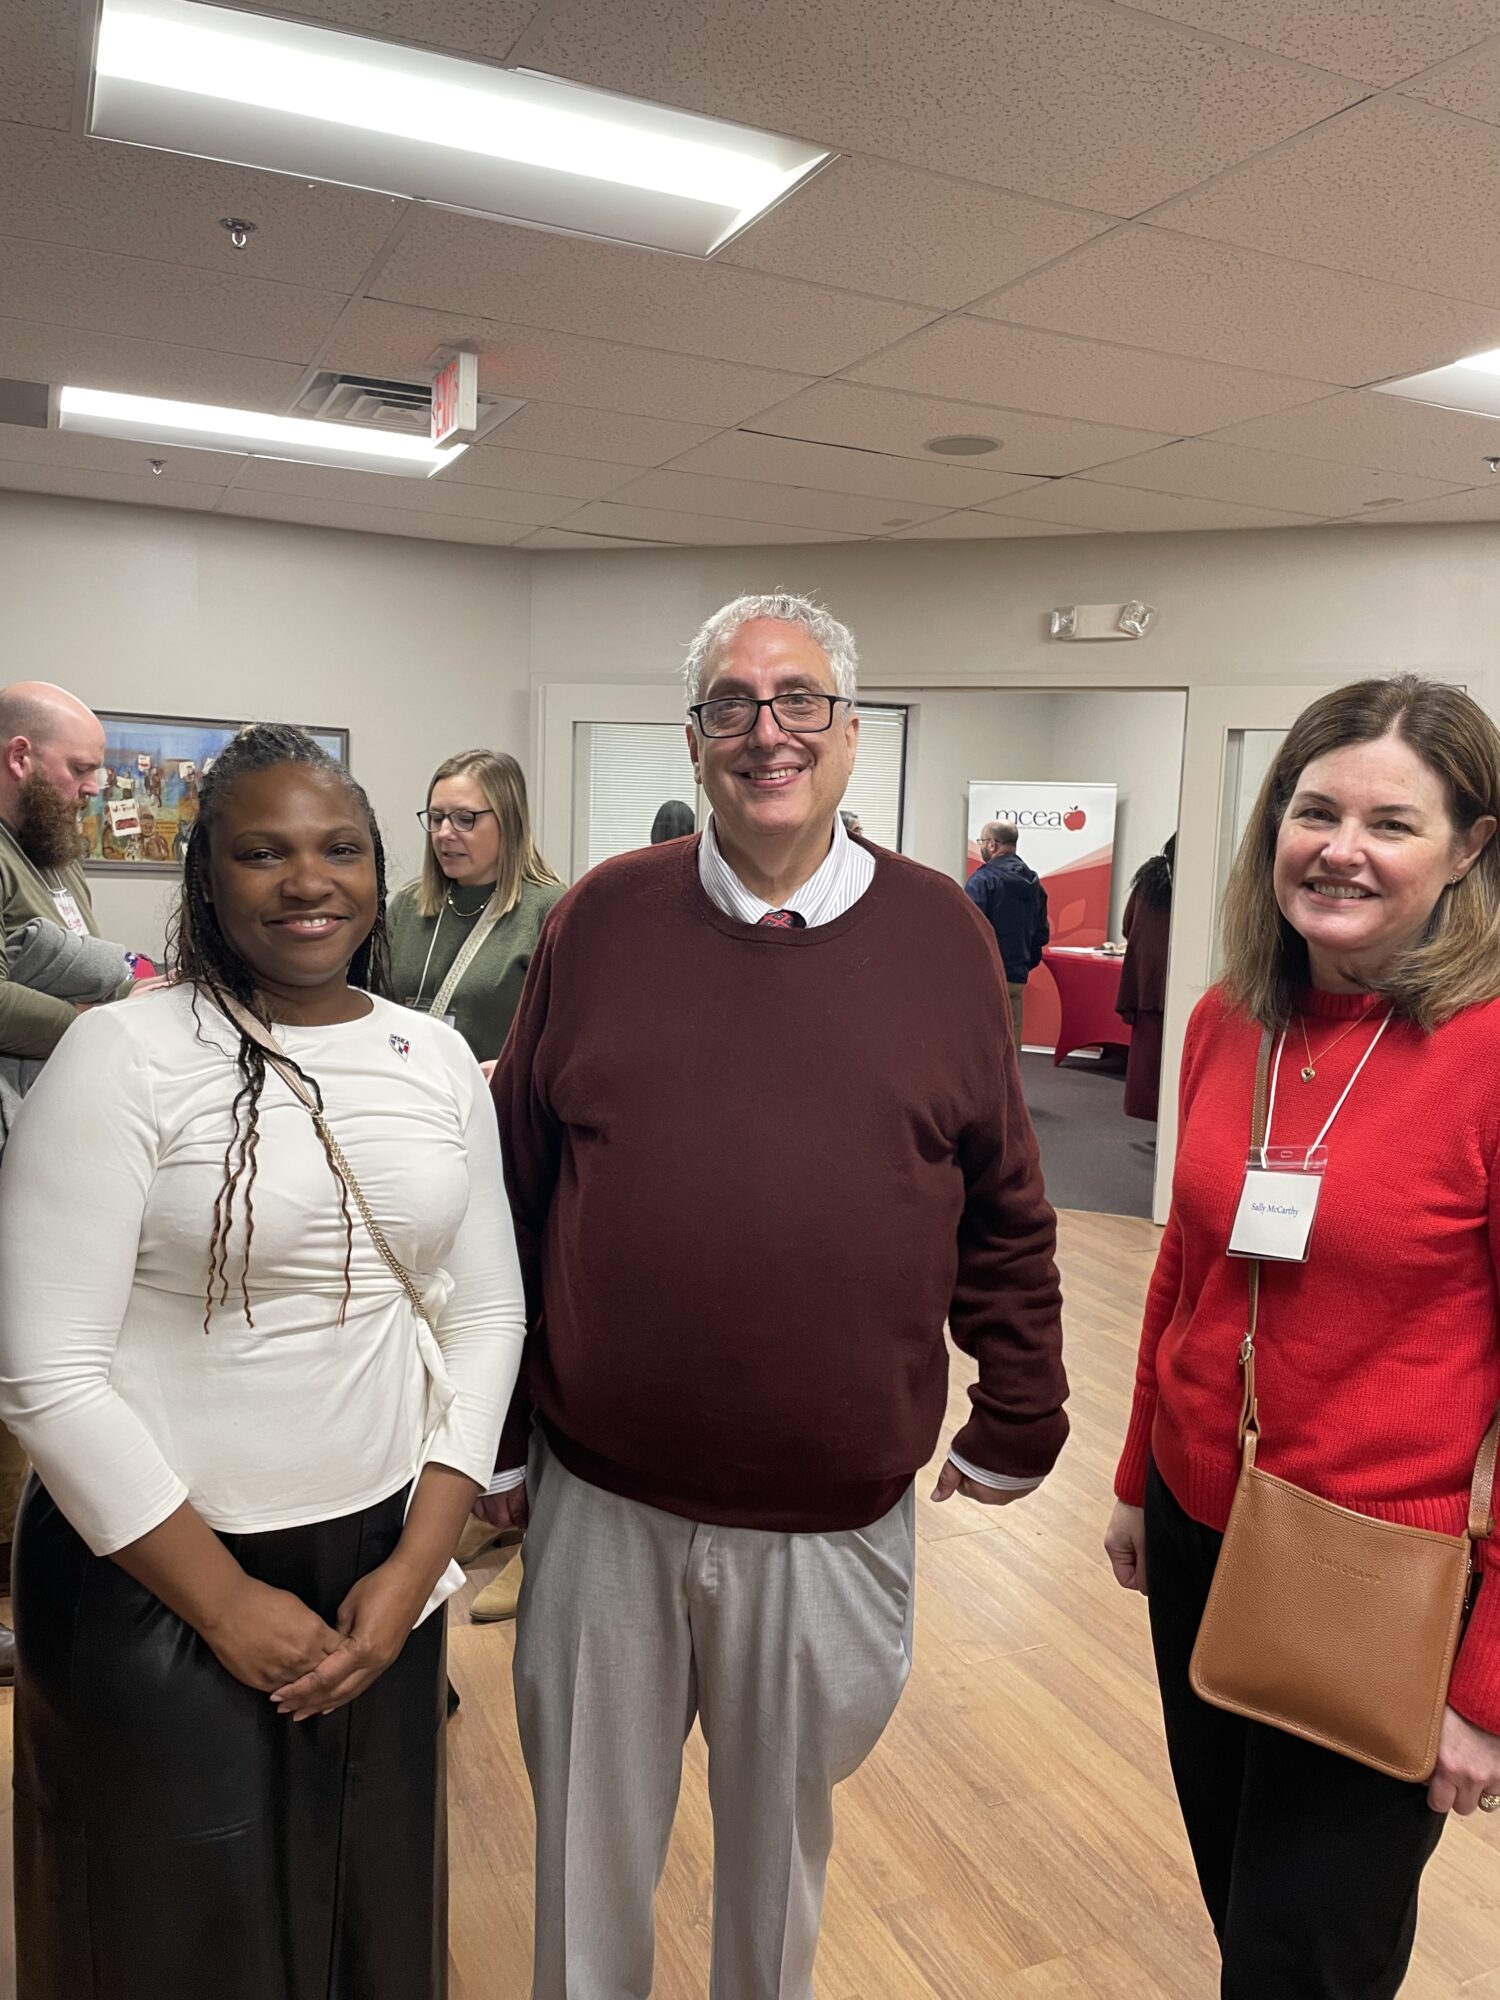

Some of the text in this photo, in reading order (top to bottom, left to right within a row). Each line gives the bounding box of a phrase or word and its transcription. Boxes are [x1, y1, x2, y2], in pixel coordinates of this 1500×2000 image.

[996, 809, 1062, 827] mcea
[1251, 1202, 1299, 1218] Sally McCarthy
